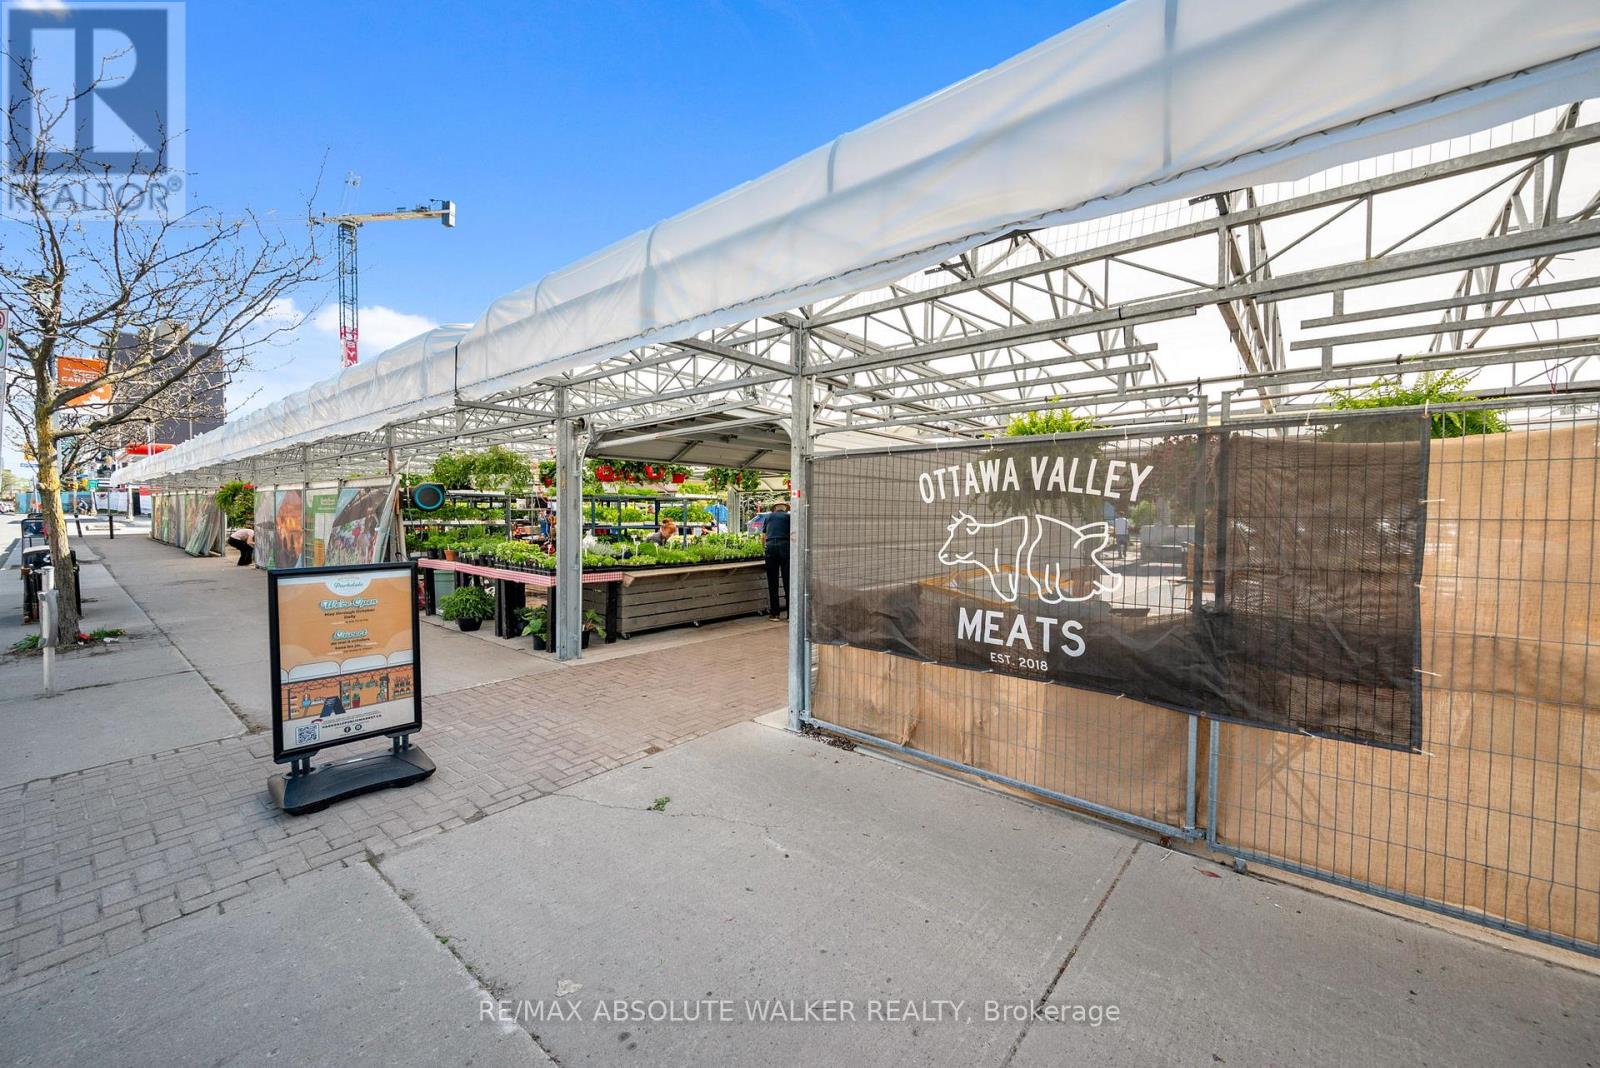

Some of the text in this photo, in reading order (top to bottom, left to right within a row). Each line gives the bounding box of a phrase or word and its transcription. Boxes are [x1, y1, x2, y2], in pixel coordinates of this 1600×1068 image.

[919, 456, 1154, 504] OTTAWA VALLEY
[352, 597, 378, 608] Open
[957, 607, 1086, 658] MEATS
[990, 652, 1048, 671] EST. 2018
